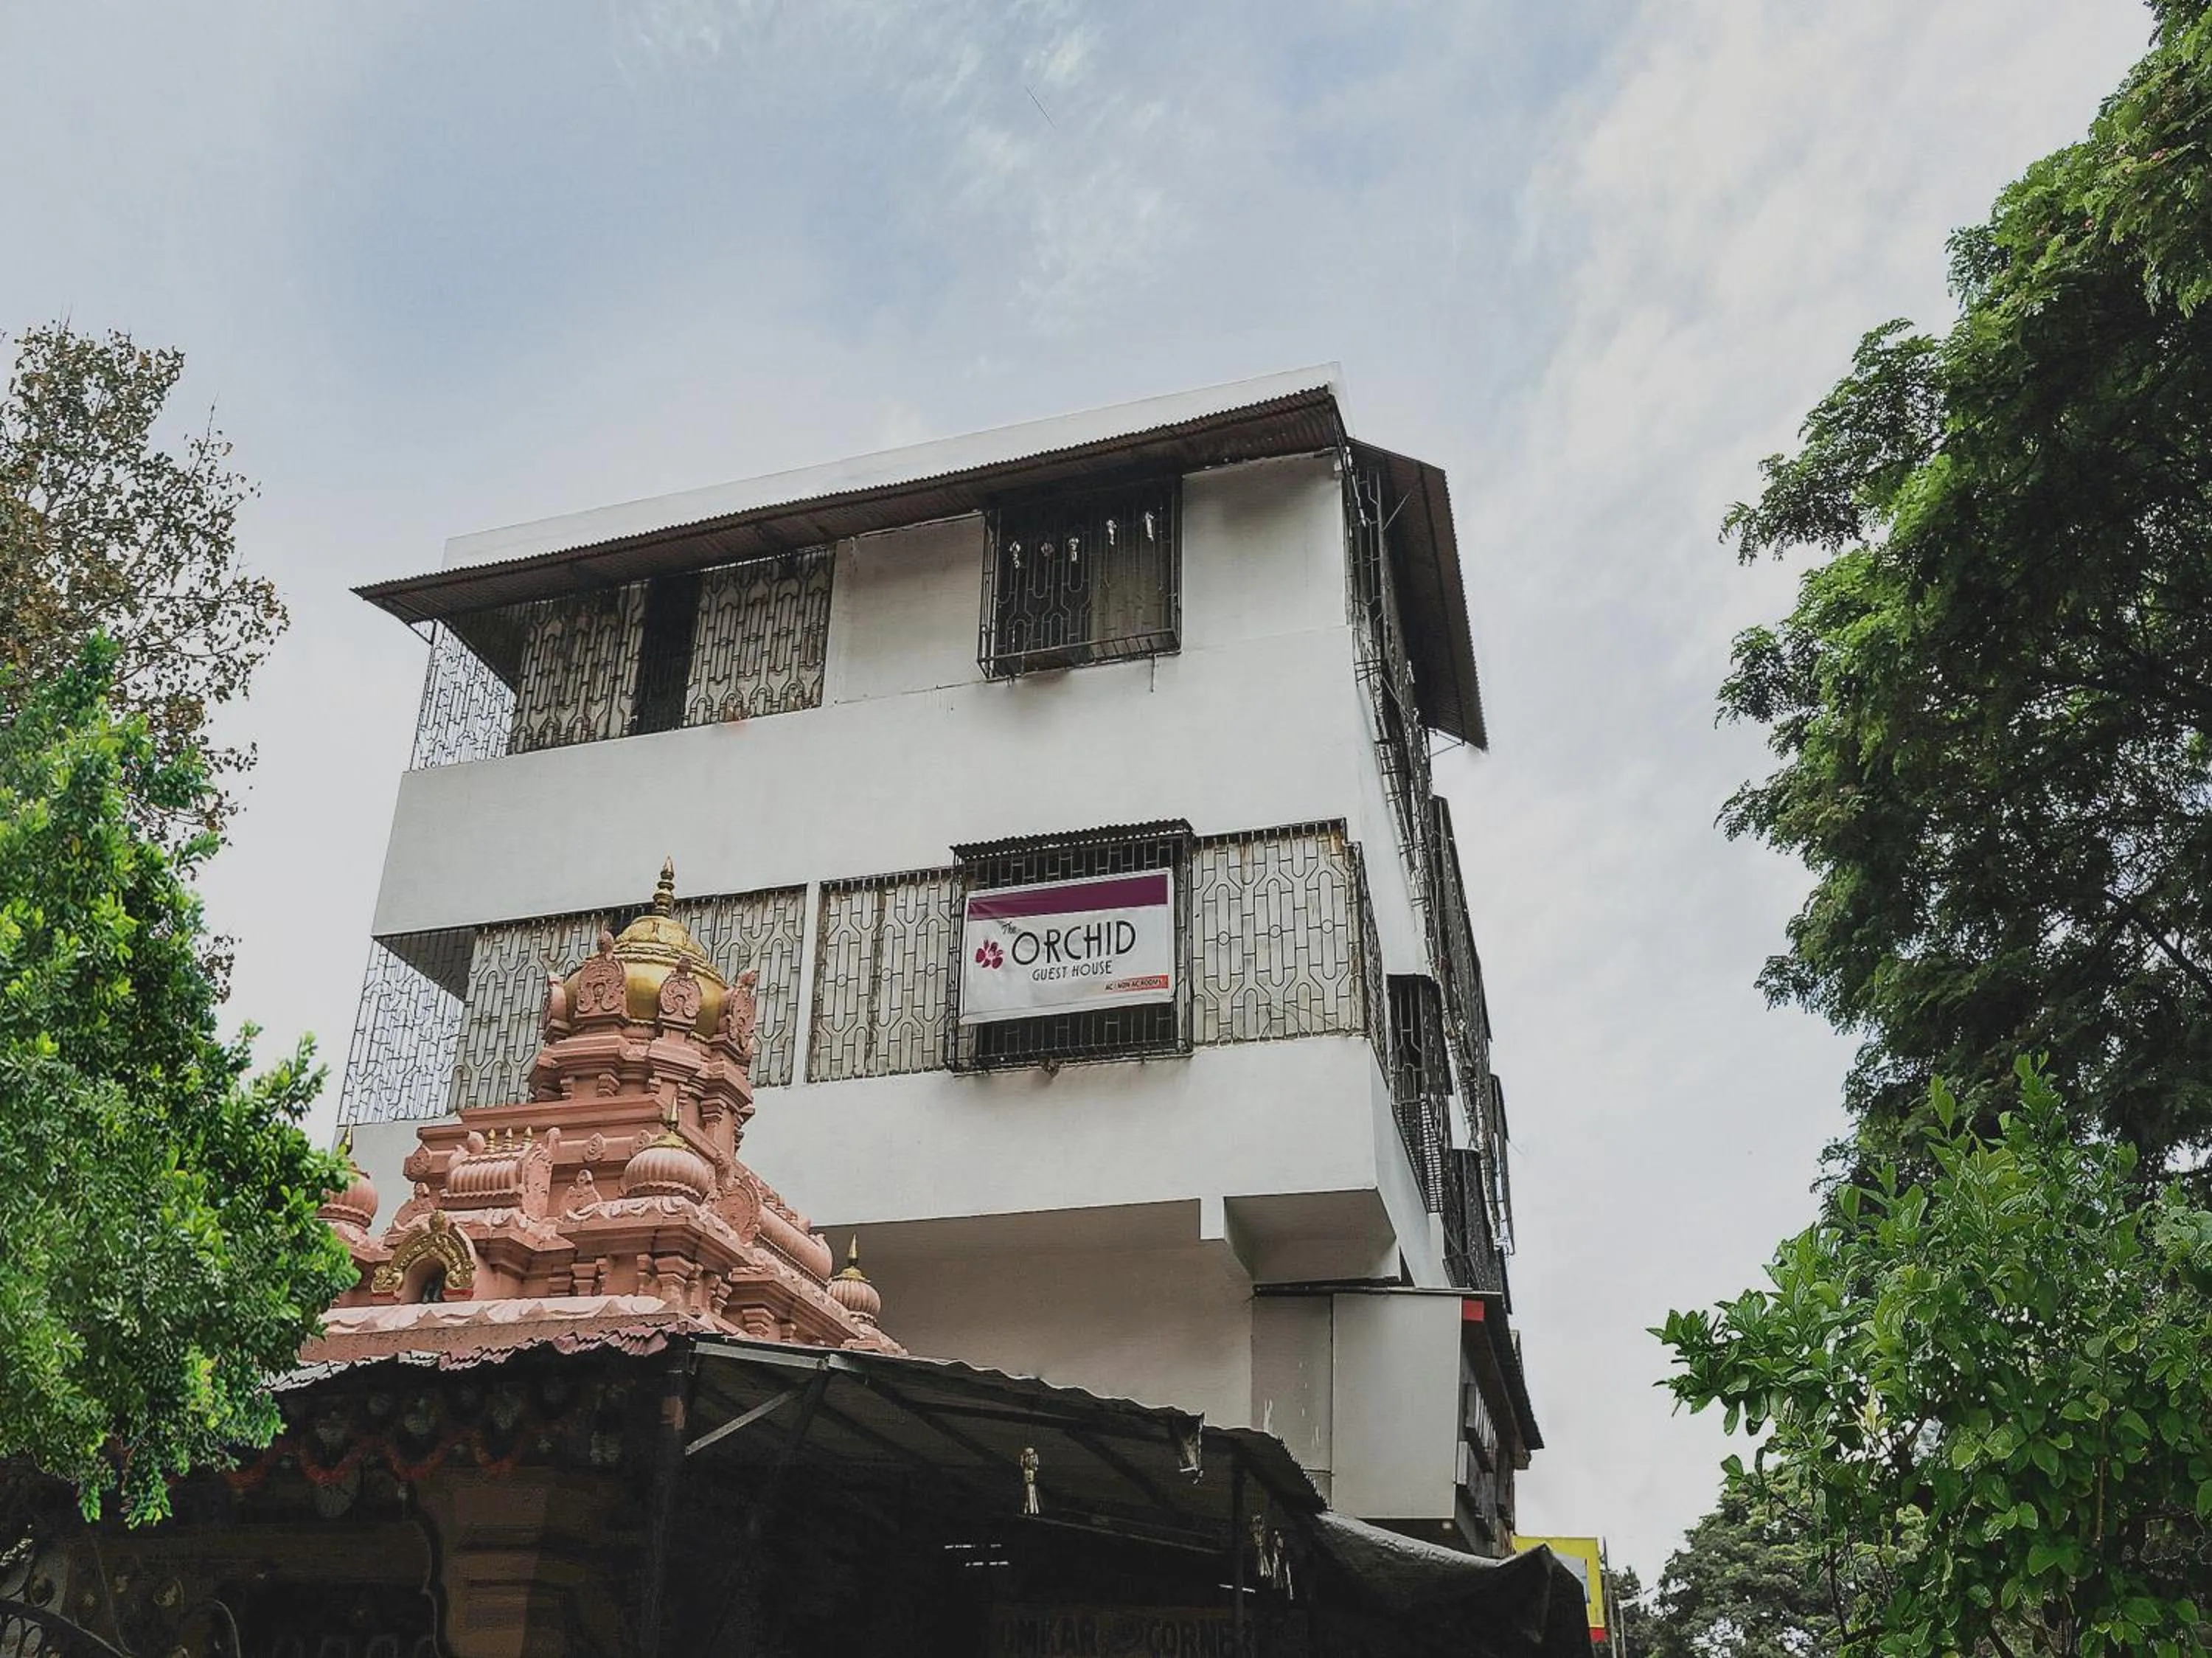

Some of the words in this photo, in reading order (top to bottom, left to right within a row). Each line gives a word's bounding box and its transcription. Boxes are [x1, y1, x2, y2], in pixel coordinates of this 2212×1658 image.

[1003, 921, 1018, 934] The
[1012, 920, 1135, 965] ORCHID
[1032, 966, 1068, 981] GUEST
[1071, 960, 1113, 977] HOUSE
